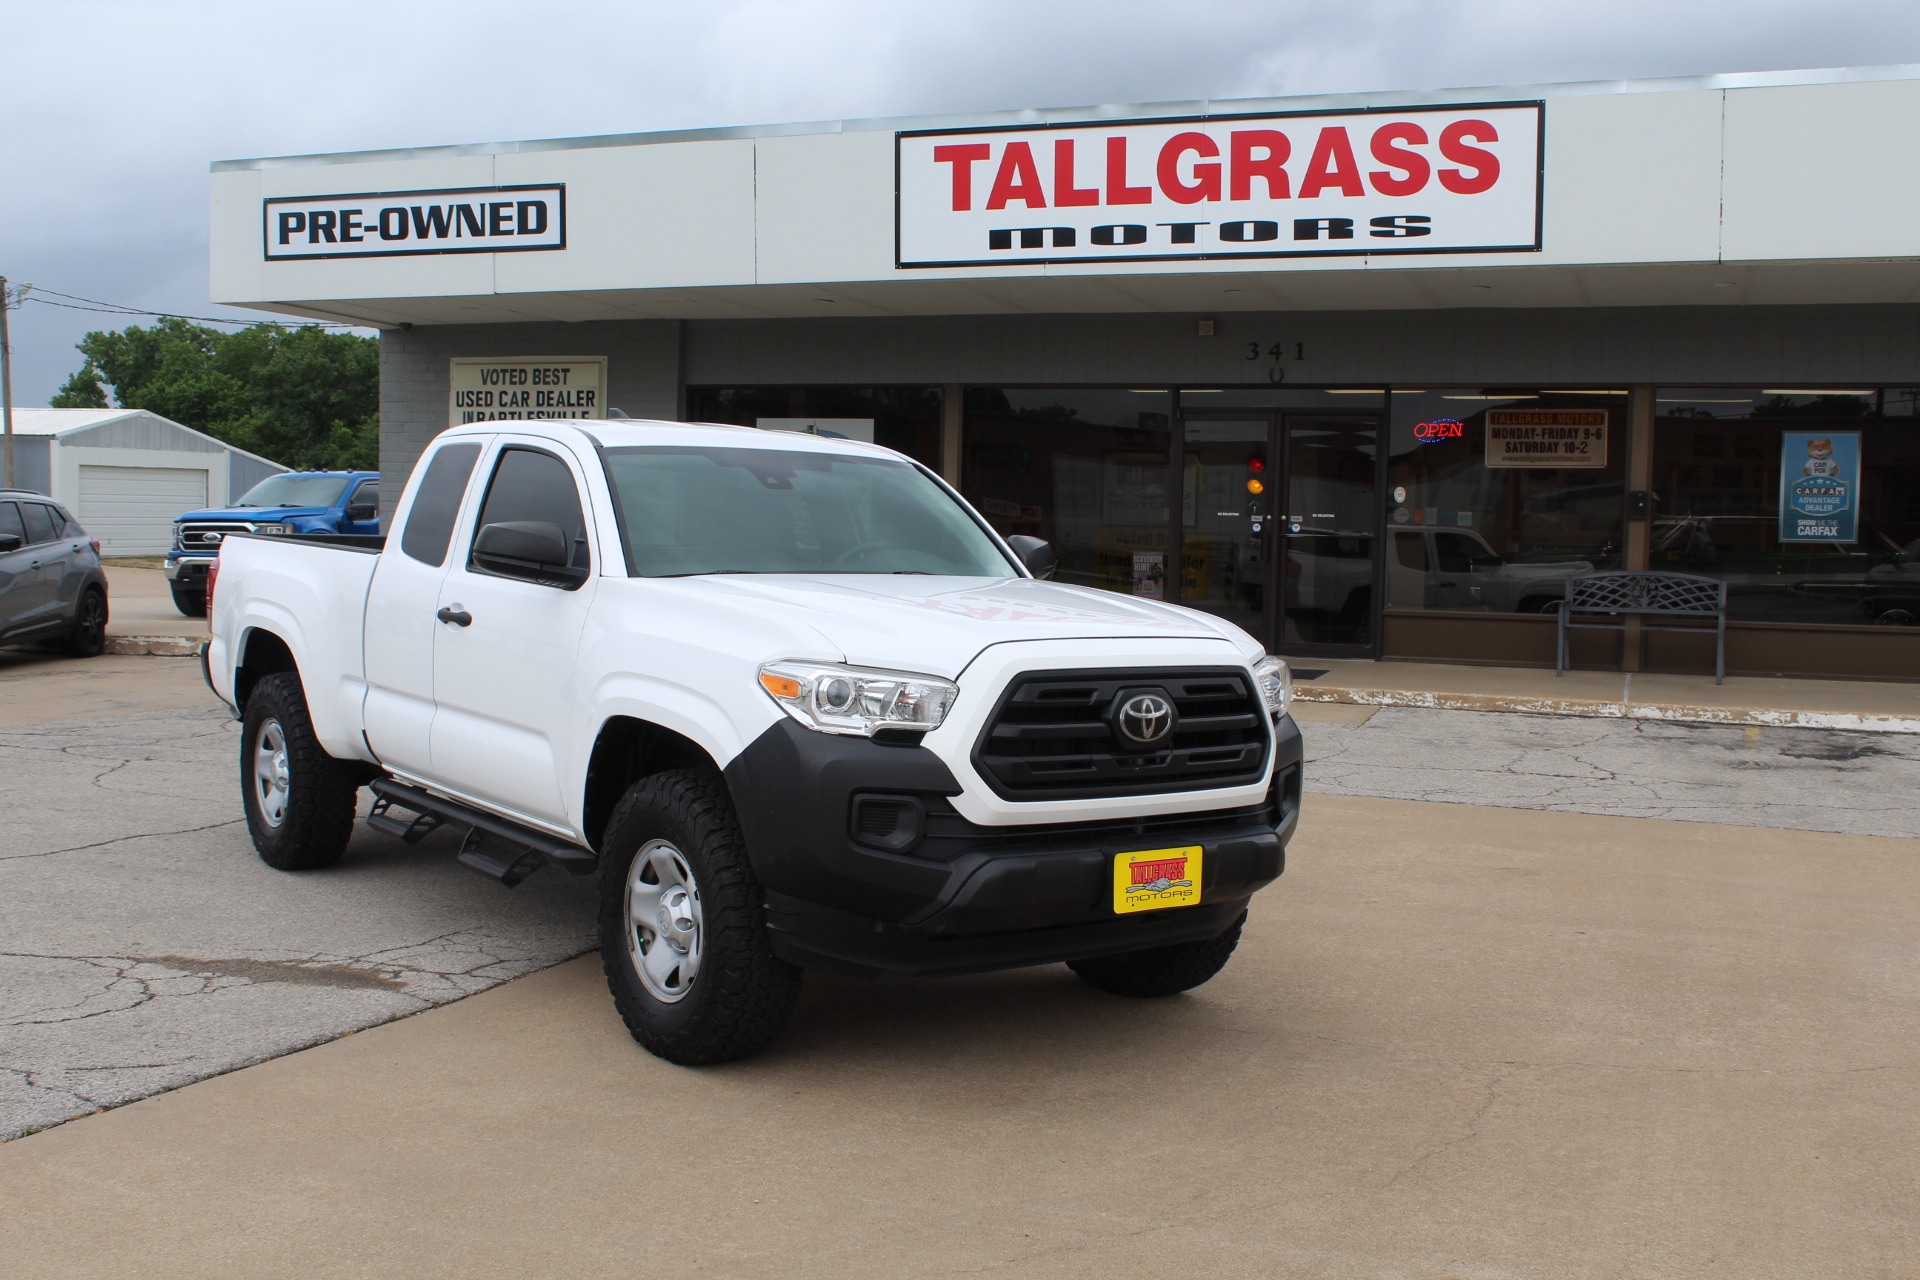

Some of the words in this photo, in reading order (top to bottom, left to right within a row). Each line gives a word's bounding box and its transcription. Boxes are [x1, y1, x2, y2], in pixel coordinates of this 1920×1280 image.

[934, 119, 1501, 211] TALLGRASS
[279, 200, 547, 245] PRE-OWNED
[988, 215, 1432, 250] MOTORS
[480, 368, 528, 386] VOTED
[532, 368, 571, 386] BEST
[456, 390, 494, 408] USED
[498, 390, 530, 408] CAR
[536, 390, 596, 408] DEALER
[1493, 414, 1552, 424] TALLGRASS
[1556, 413, 1602, 424] MOTORS
[1413, 422, 1465, 437] OPEN
[1491, 427, 1580, 440] MONDAY-FRIDAY
[1583, 427, 1603, 440] 9-6
[1504, 441, 1559, 454] SATURDAY
[1563, 441, 1588, 454] 10-2
[1795, 487, 1845, 496] CARFAX
[1797, 526, 1839, 536] CARFAX
[1100, 551, 1131, 567] Used
[1133, 555, 1164, 563] SCAVENGER
[1134, 563, 1150, 571] HUNT
[1129, 857, 1188, 885] TALLGRASS
[1126, 890, 1193, 902] MOTORS
